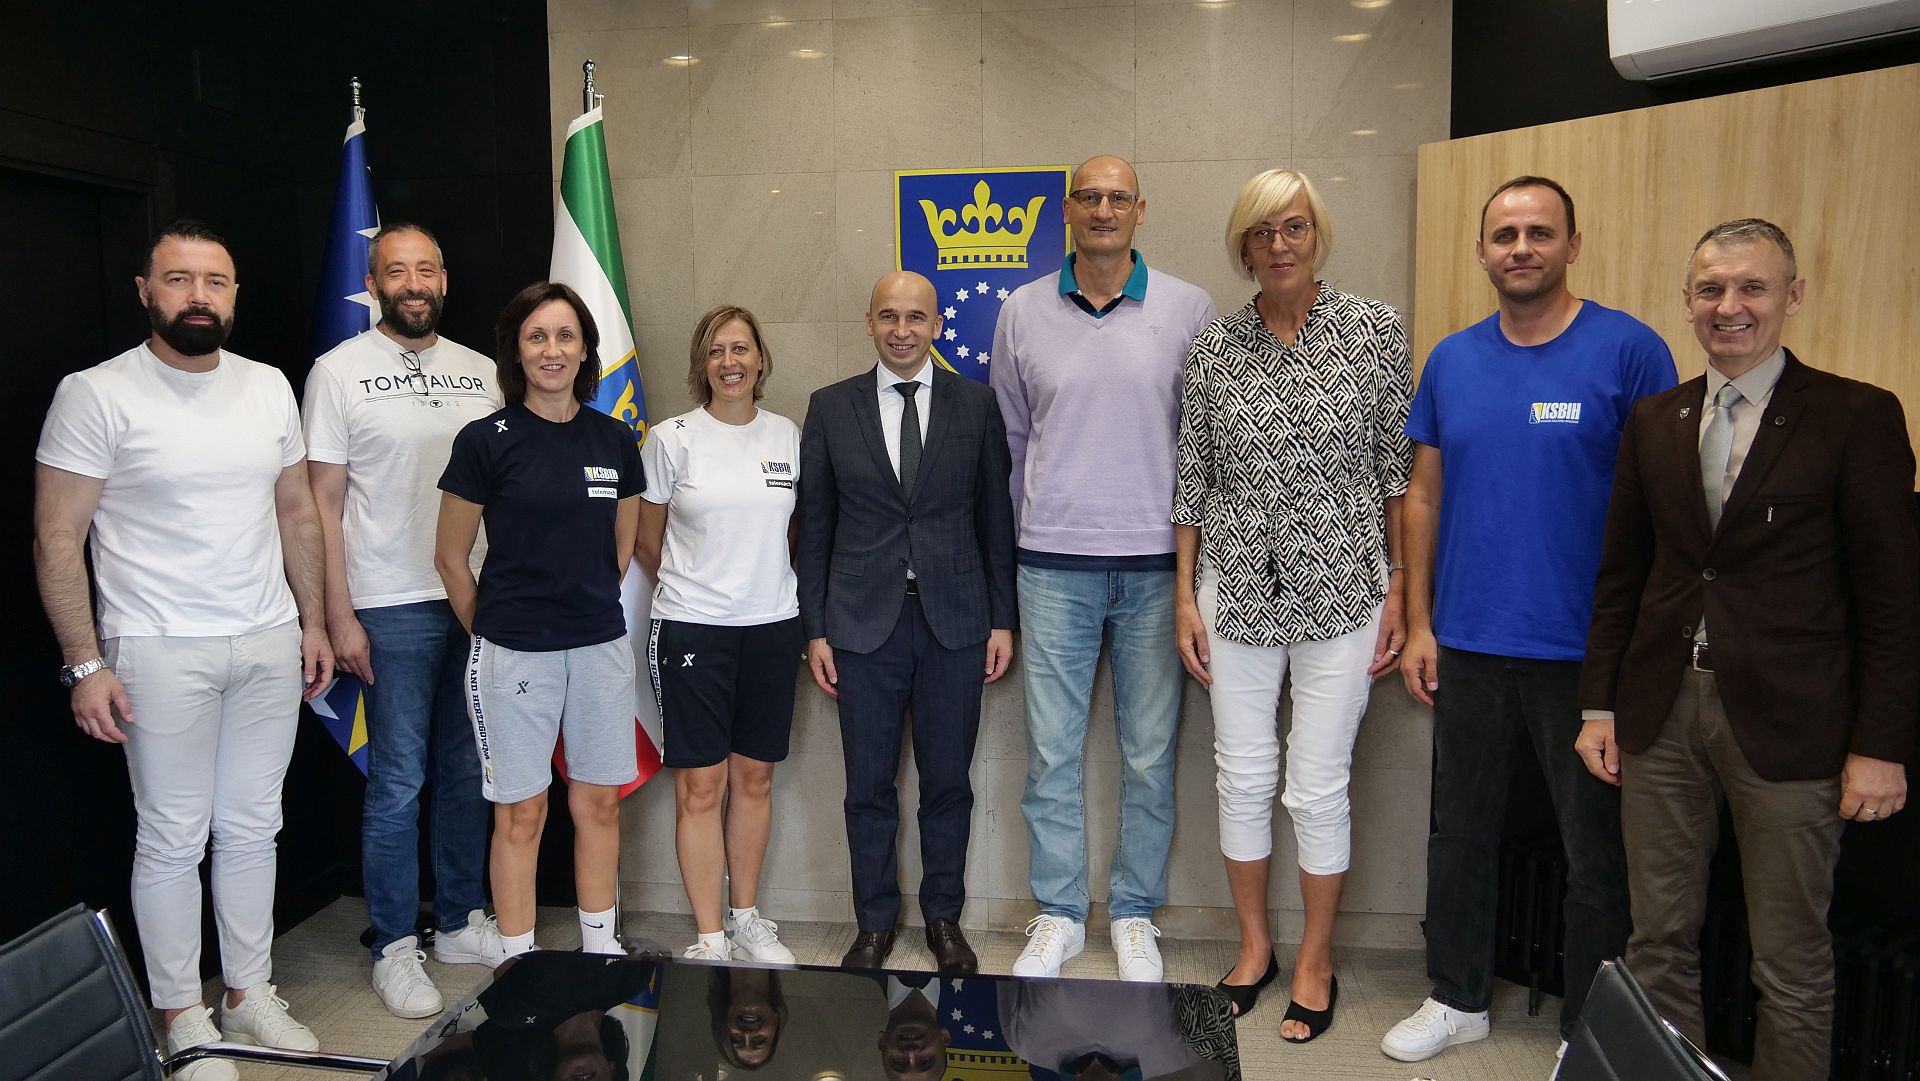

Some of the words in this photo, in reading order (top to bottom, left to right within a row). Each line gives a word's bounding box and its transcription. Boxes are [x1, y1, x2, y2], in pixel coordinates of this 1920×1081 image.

[360, 375, 412, 393] TOM
[1541, 403, 1581, 419] KSBIH
[592, 467, 619, 479] KSBIH
[768, 461, 791, 473] KSBIH
[473, 694, 490, 760] HERZEGOVINA
